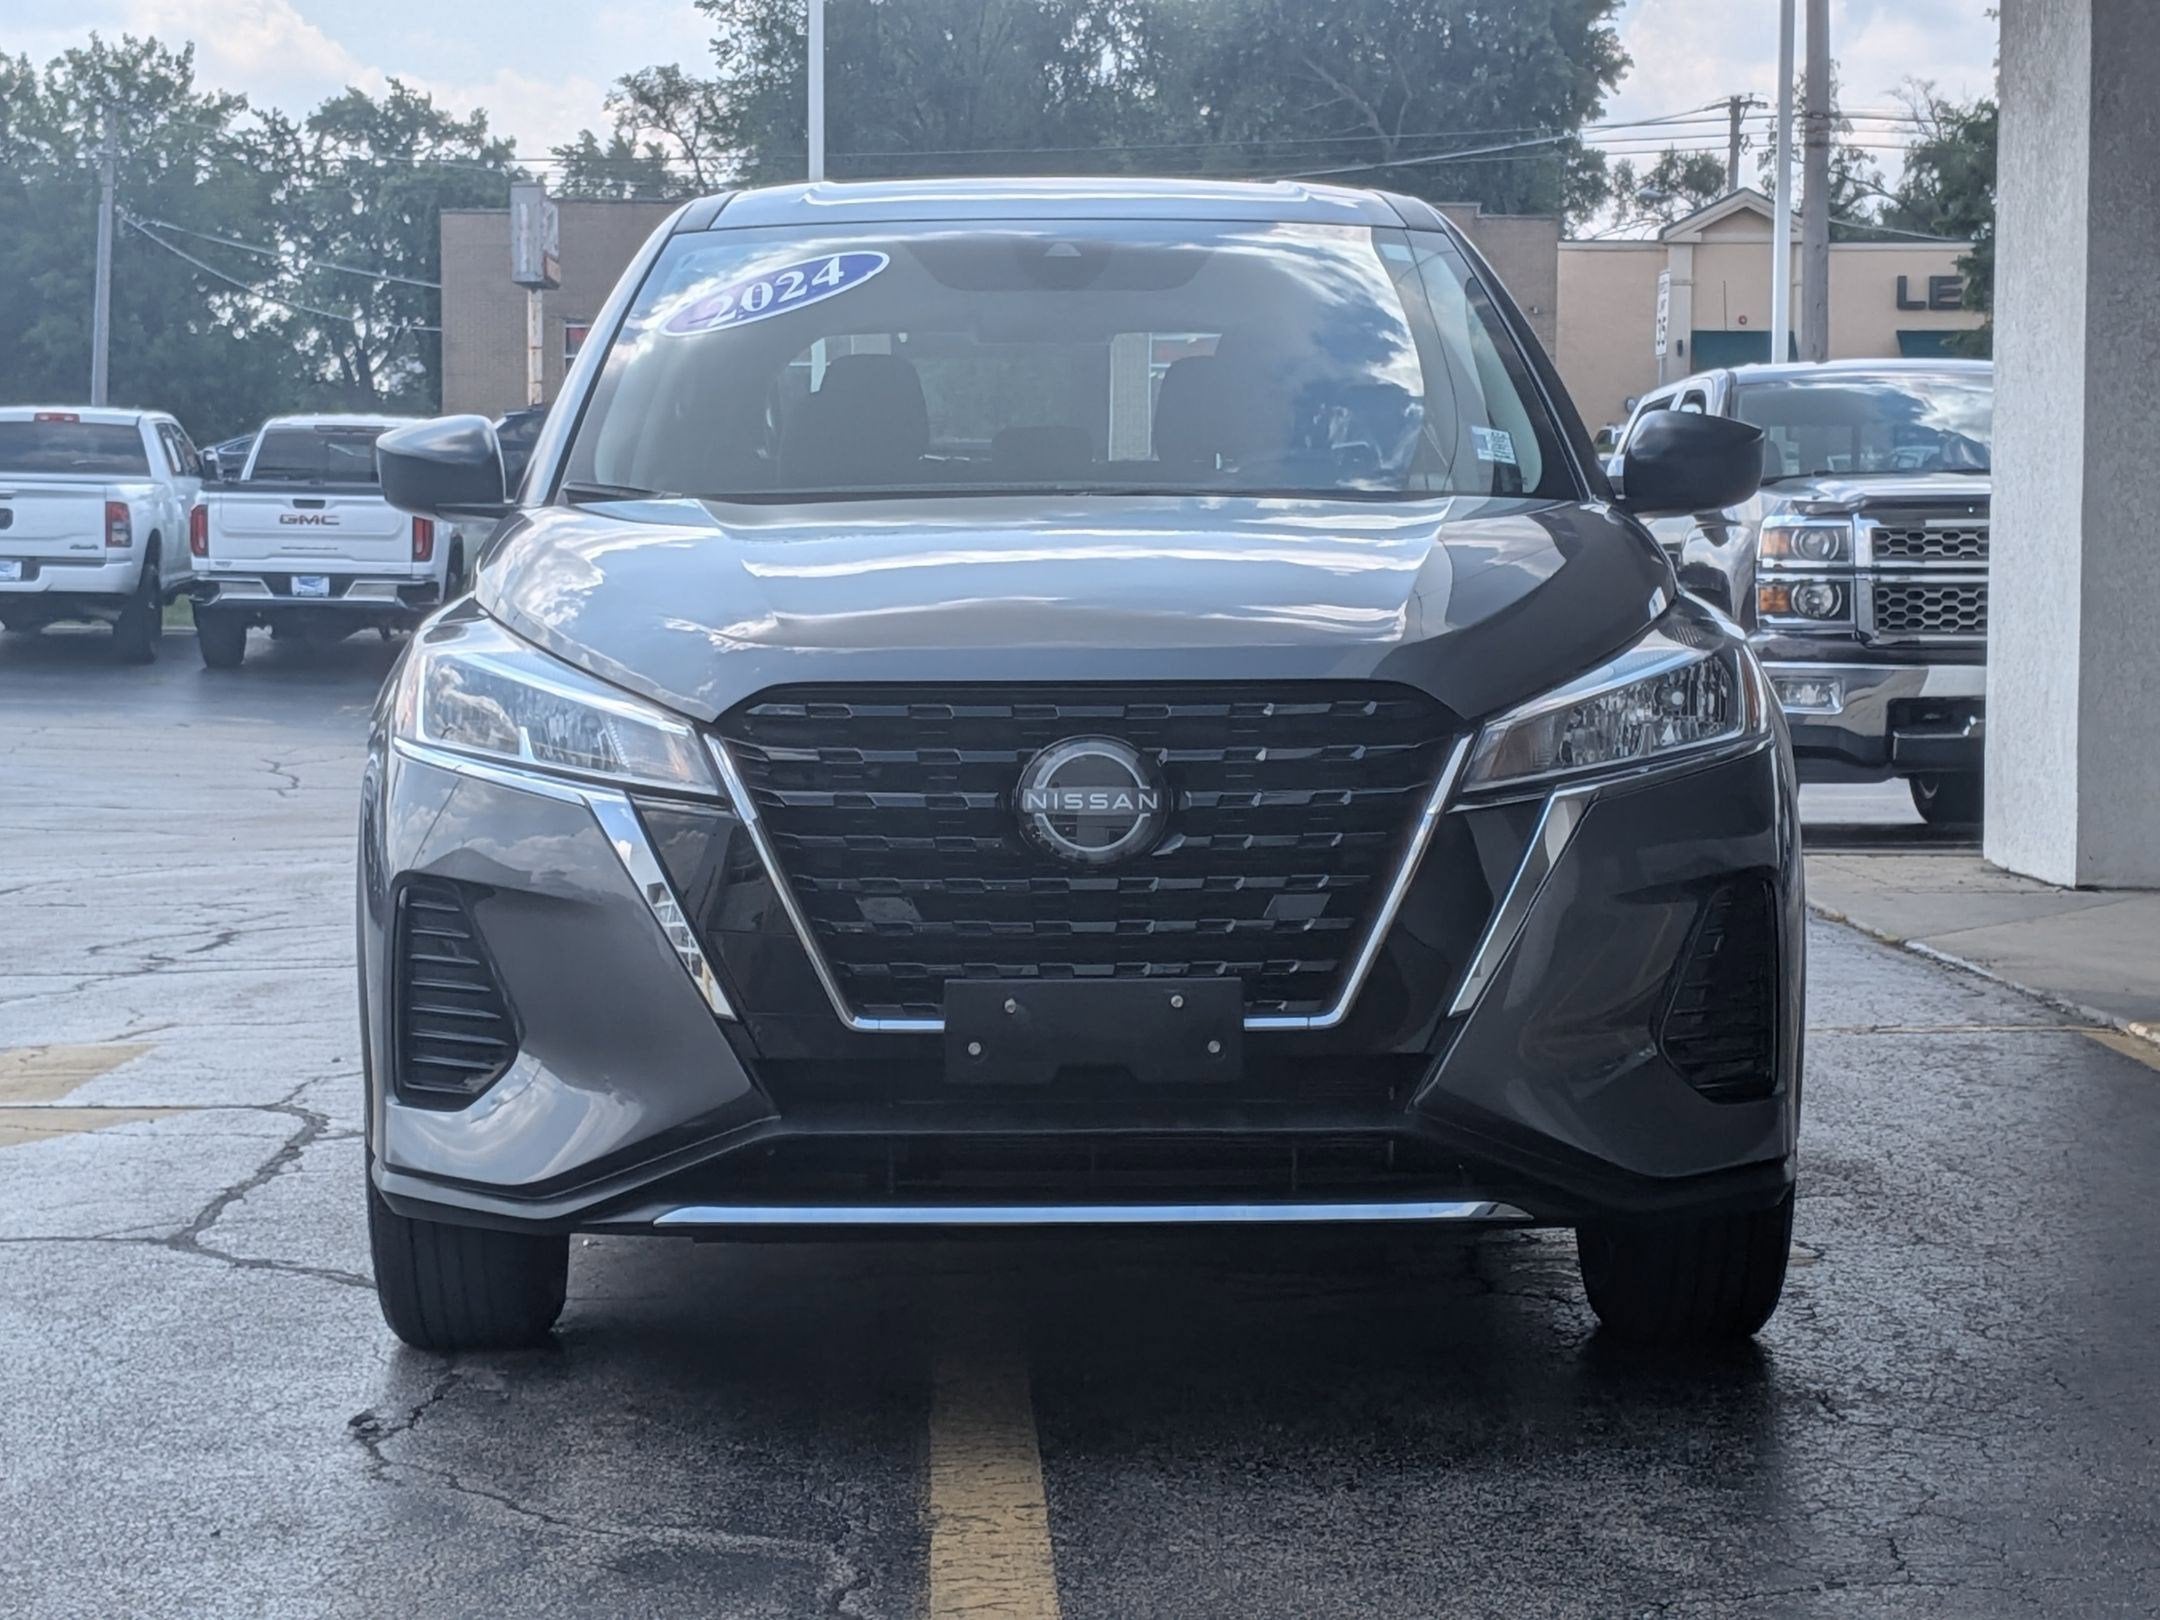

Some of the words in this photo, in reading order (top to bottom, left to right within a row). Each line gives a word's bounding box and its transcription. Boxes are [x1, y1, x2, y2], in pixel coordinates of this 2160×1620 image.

[706, 255, 845, 328] 2024
[279, 514, 340, 526] GMC
[1027, 792, 1157, 810] NISSAN
